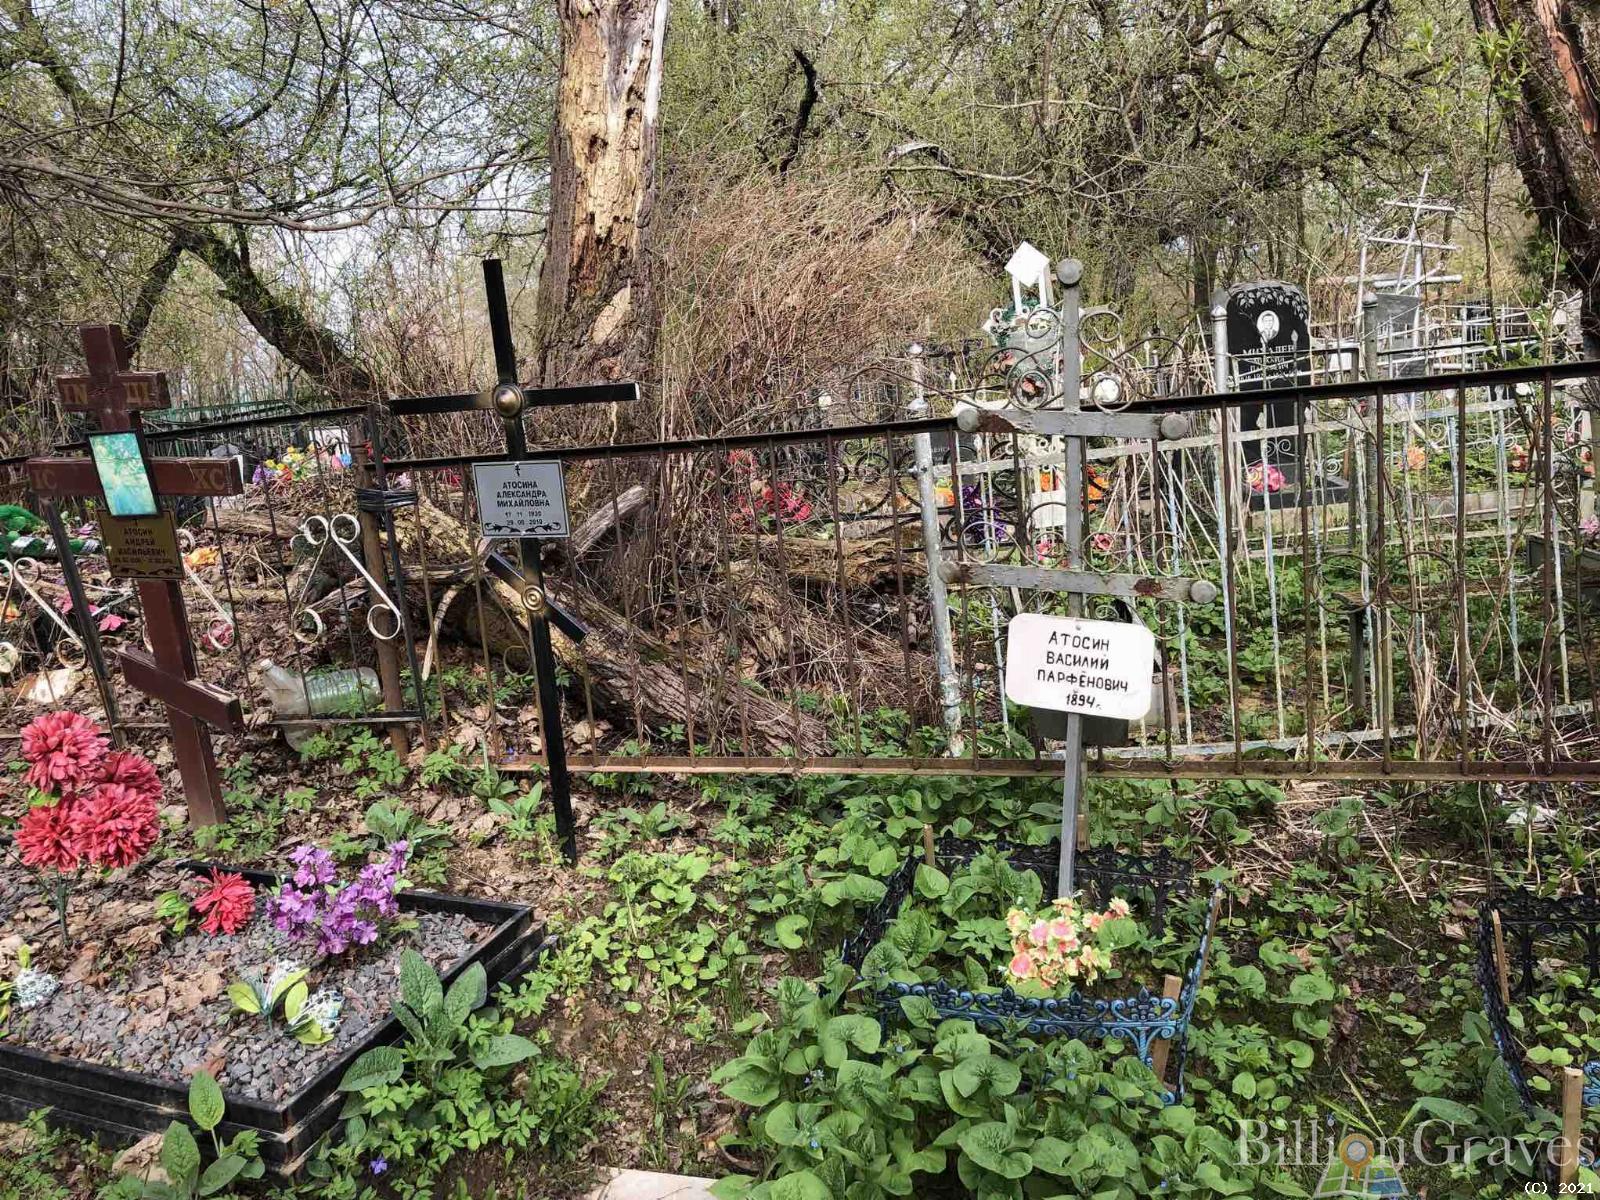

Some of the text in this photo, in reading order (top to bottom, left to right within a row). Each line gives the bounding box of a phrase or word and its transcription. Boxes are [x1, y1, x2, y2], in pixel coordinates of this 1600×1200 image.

[502, 480, 538, 489] АТОСИНА
[497, 489, 547, 499] АЛЕКСАНДРА
[497, 498, 550, 508] МИХАЙЛОВНА
[1048, 630, 1110, 651] АТОСИН
[1046, 651, 1109, 670] ВАСИЛИЙ
[1037, 669, 1128, 692] ПАРФЁНОВИЧ
